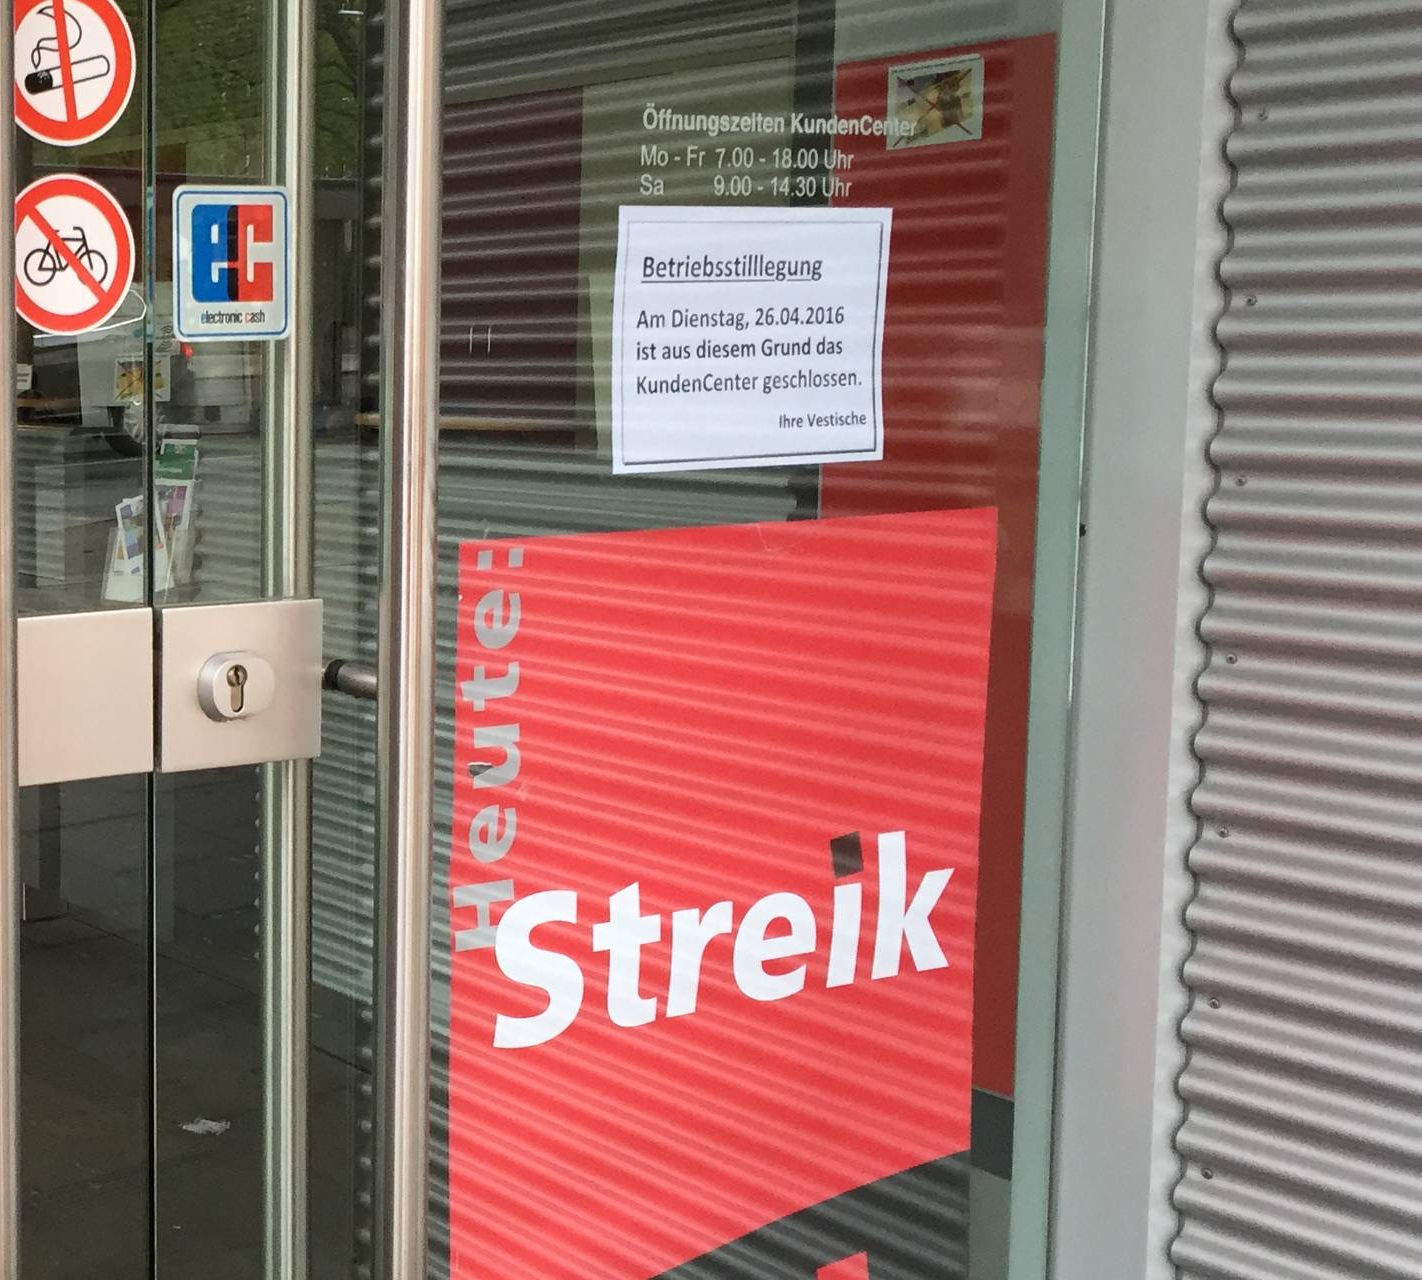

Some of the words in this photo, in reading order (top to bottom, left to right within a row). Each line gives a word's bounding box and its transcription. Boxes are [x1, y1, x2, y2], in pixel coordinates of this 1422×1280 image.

[642, 103, 785, 136] Öffnungszeiten
[791, 112, 917, 137] KundenCenter
[640, 145, 669, 167] Mo
[686, 147, 706, 168] Fr
[715, 147, 753, 169] 7.00
[773, 147, 819, 169] 18.00
[823, 149, 855, 170] Uhr
[640, 174, 665, 196] Sa
[713, 175, 752, 197] 9.00
[770, 175, 817, 197] 14.30
[821, 176, 852, 198] Uhr
[641, 254, 824, 282] Betriebsstilllegung
[200, 310, 243, 325] electronic
[245, 308, 266, 324] cash
[636, 310, 666, 329] Am
[671, 309, 750, 331] Dienstag,
[755, 306, 845, 326] 26.04.2016
[636, 341, 657, 361] ist
[662, 342, 691, 360] aus
[696, 339, 756, 359] diesem
[761, 338, 811, 357] Grund
[816, 336, 843, 355] das
[636, 373, 759, 395] KundenCenter
[762, 369, 863, 395] geschlossen.
[778, 414, 804, 429] Ihre
[807, 411, 868, 428] Vestische
[453, 547, 525, 953] Heute:
[492, 829, 955, 1049] Streik
